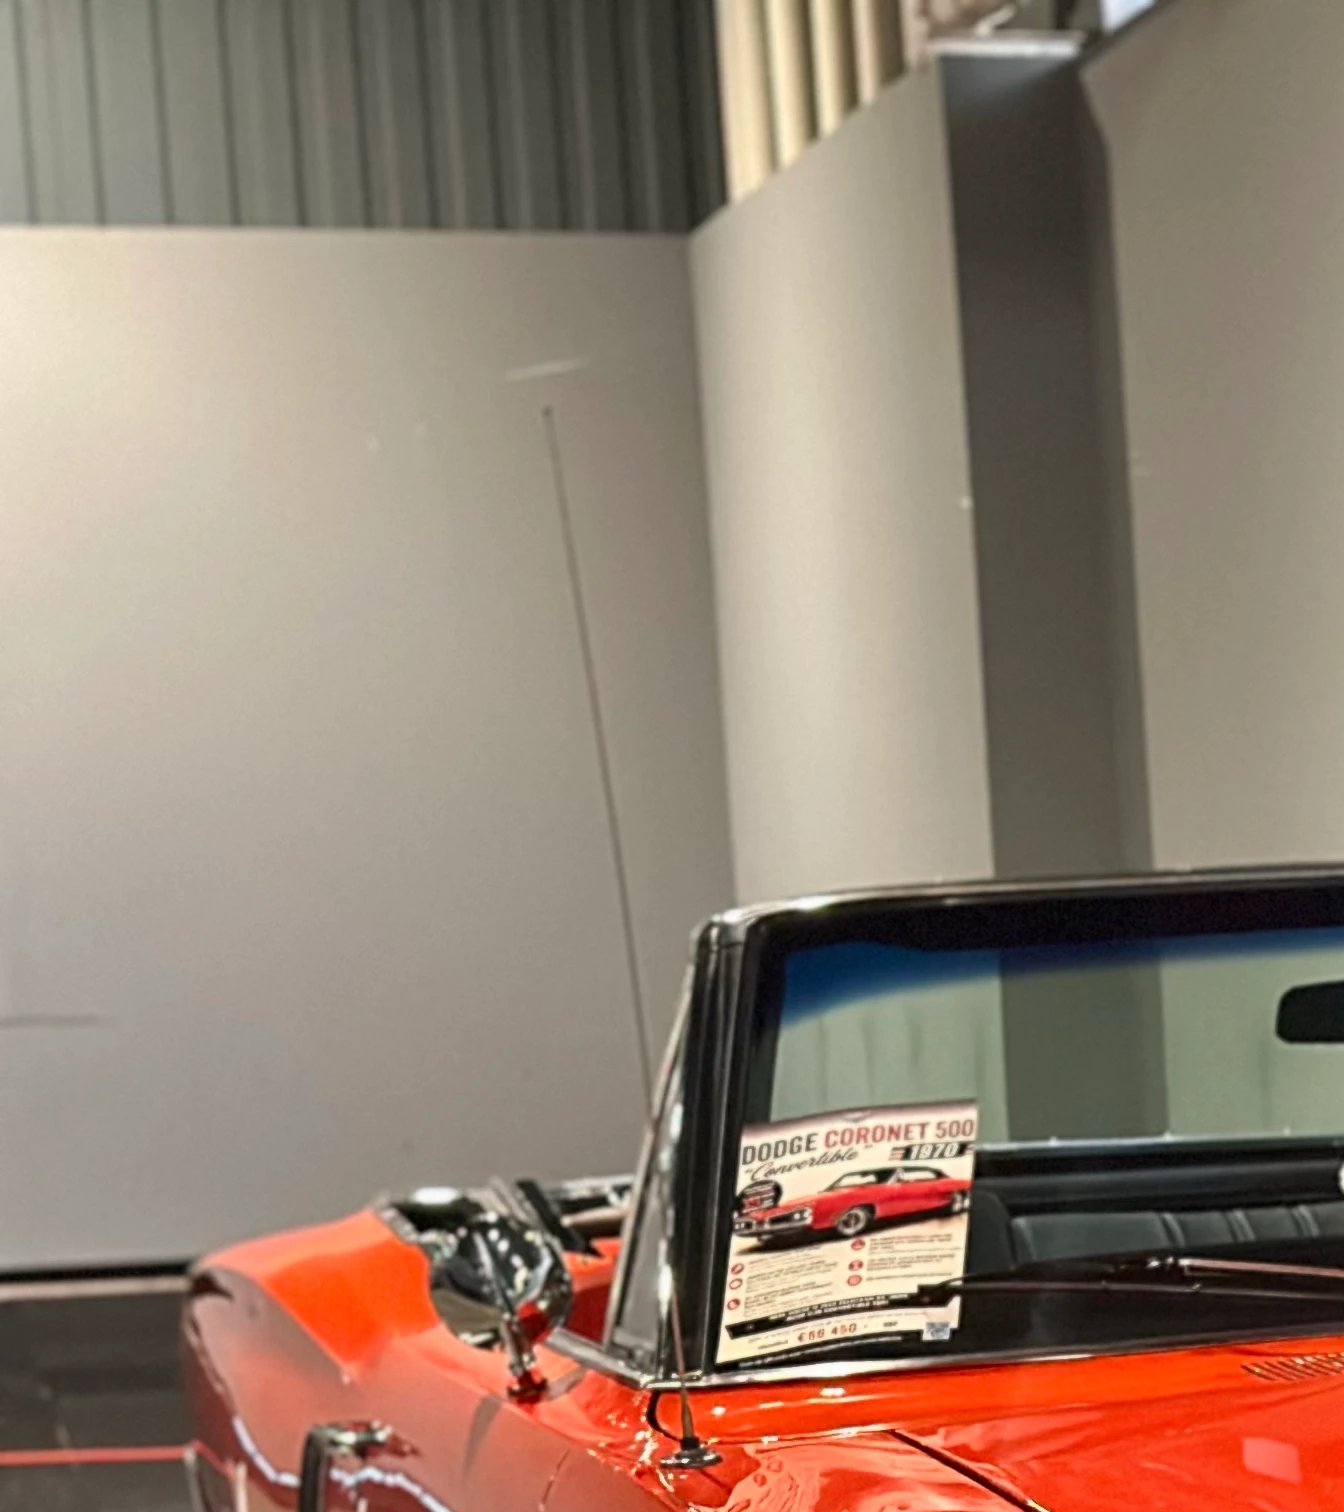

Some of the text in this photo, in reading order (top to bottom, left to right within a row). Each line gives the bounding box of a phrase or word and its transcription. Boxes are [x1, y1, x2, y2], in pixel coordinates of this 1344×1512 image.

[742, 1119, 975, 1166] DODGE CORONET 500
[908, 1142, 959, 1161] 1970
